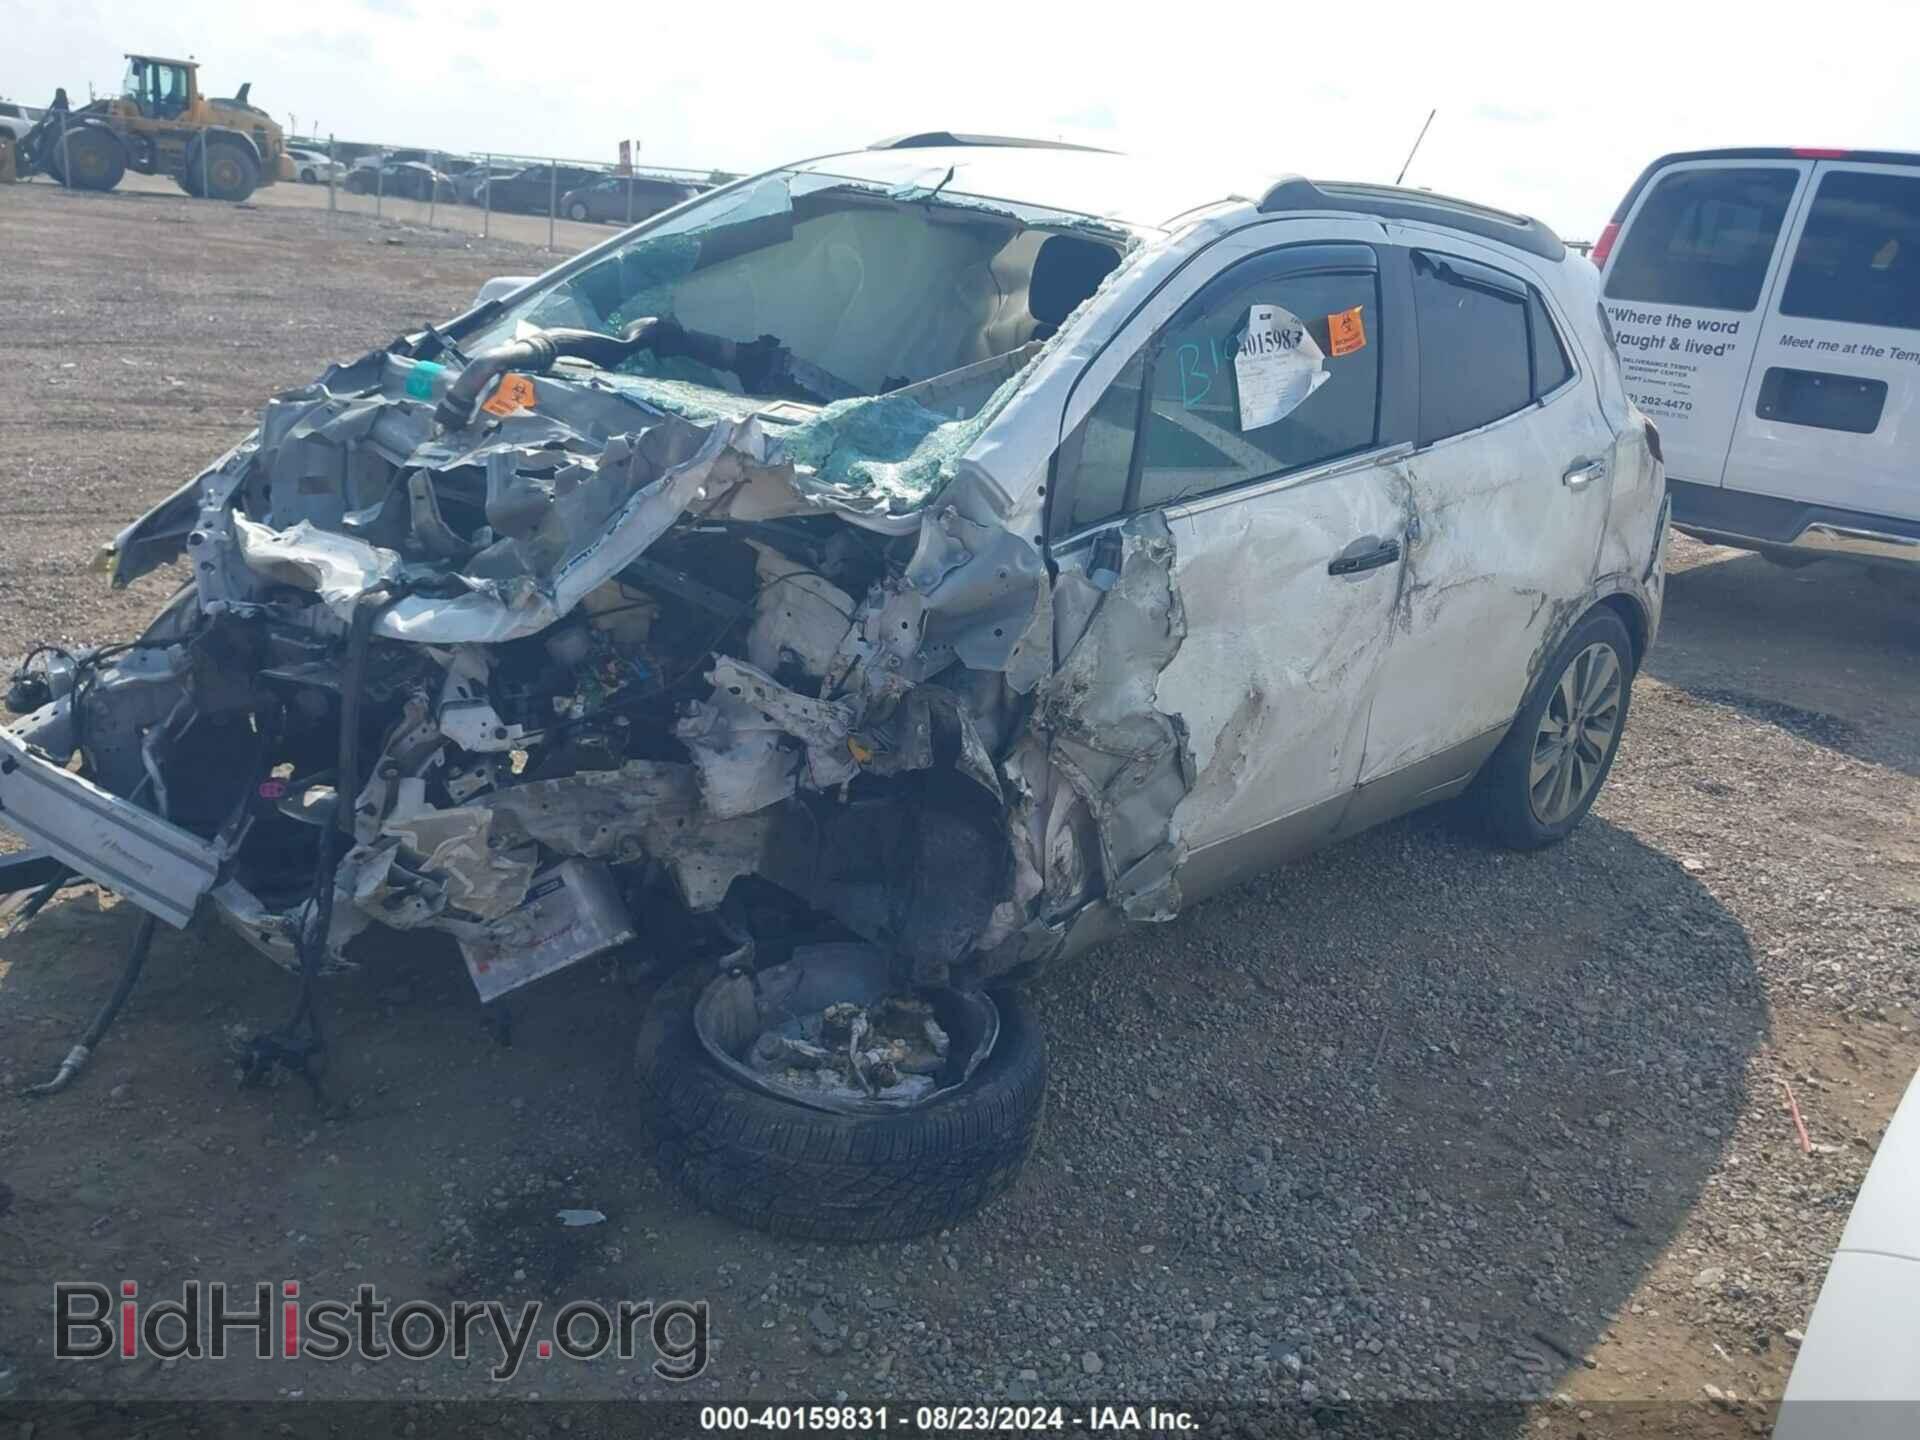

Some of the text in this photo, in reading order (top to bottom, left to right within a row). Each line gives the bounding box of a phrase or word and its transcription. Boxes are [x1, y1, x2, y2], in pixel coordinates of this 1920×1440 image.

[1666, 313, 1692, 329] the
[1697, 320, 1740, 335] word
[1616, 331, 1665, 351] taught
[1669, 337, 1681, 351] &
[1779, 334, 1814, 349] Meet
[1816, 340, 1840, 352] me
[1842, 343, 1858, 354] at
[1861, 344, 1885, 357] the
[1660, 370, 1687, 378] CENTER
[1641, 395, 1693, 411] 202-4470
